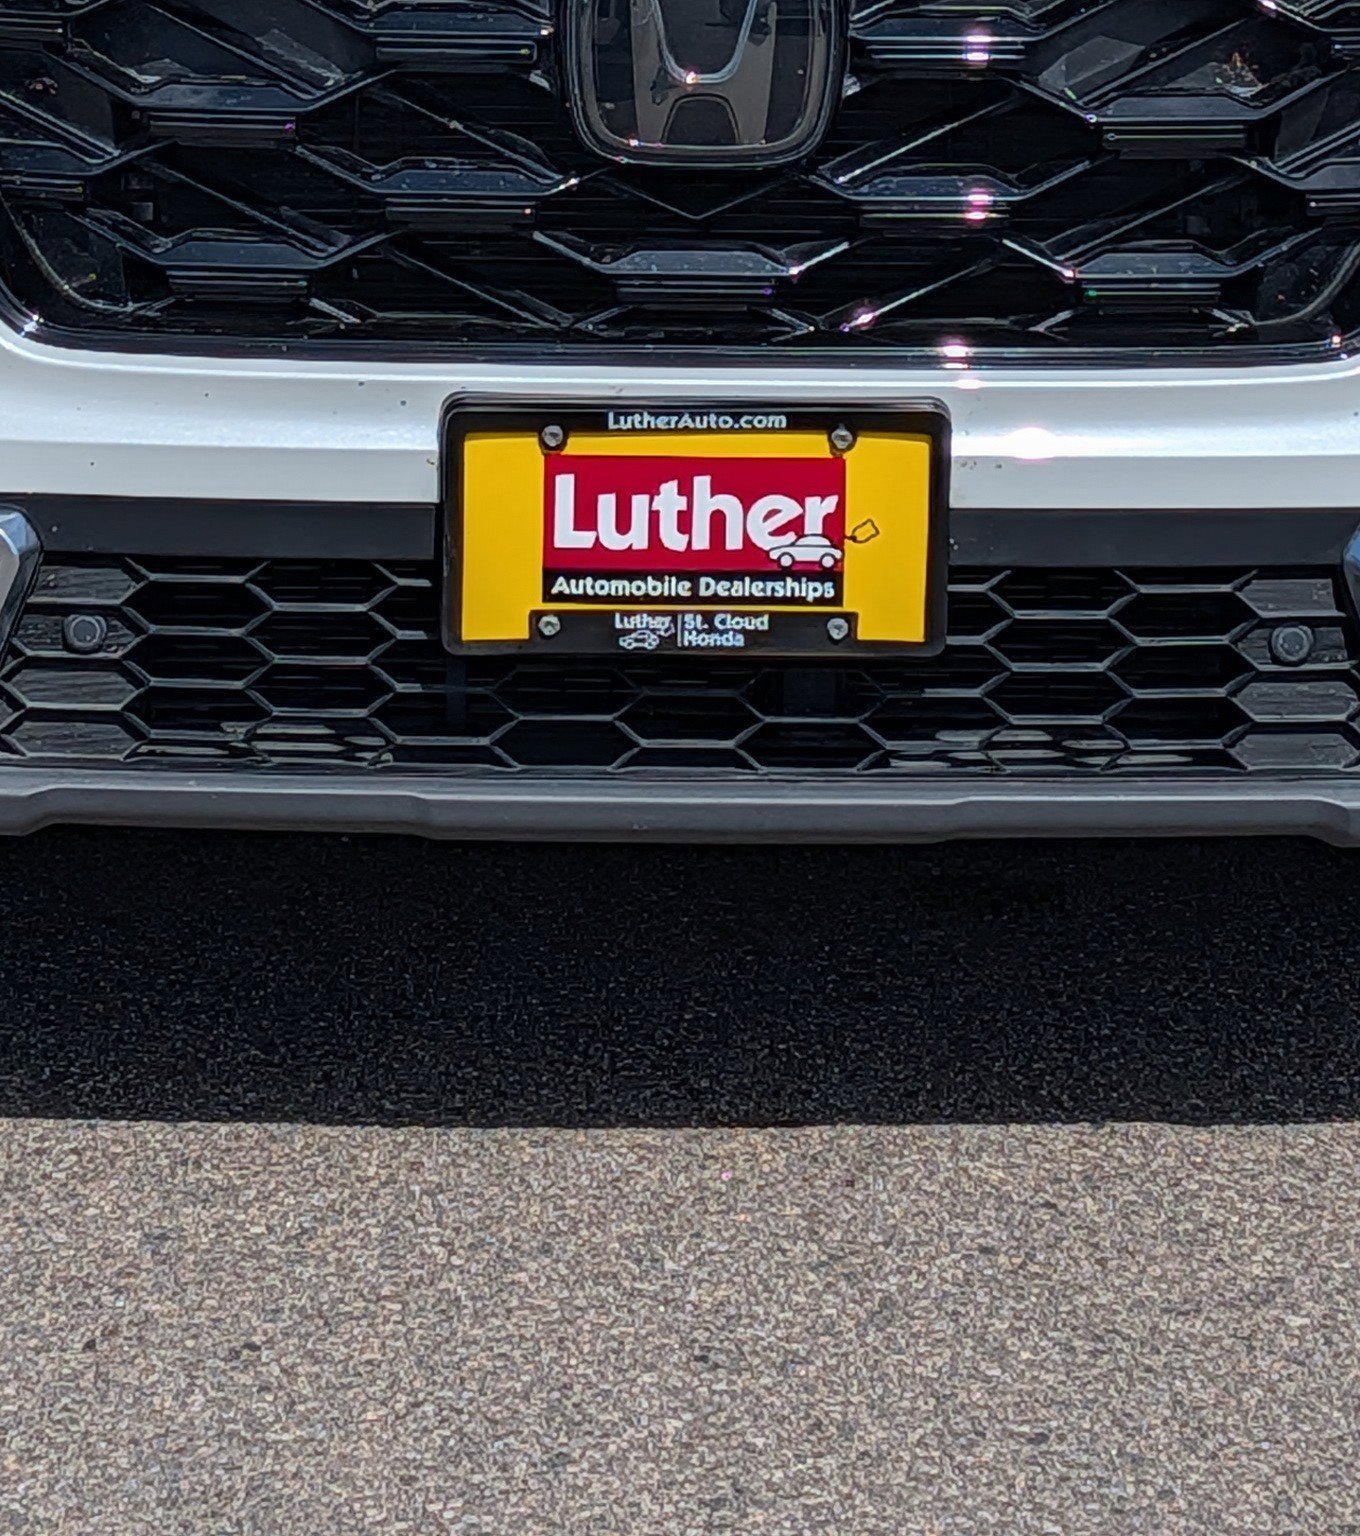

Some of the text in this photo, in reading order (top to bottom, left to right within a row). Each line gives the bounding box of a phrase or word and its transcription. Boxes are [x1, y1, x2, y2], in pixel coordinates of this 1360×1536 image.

[607, 411, 787, 430] LutherAuto.com
[552, 473, 839, 552] Luther
[551, 575, 835, 602] Automobile Dealerships
[683, 613, 709, 630] St.
[714, 613, 769, 630] Cloud
[683, 630, 745, 648] Honda
